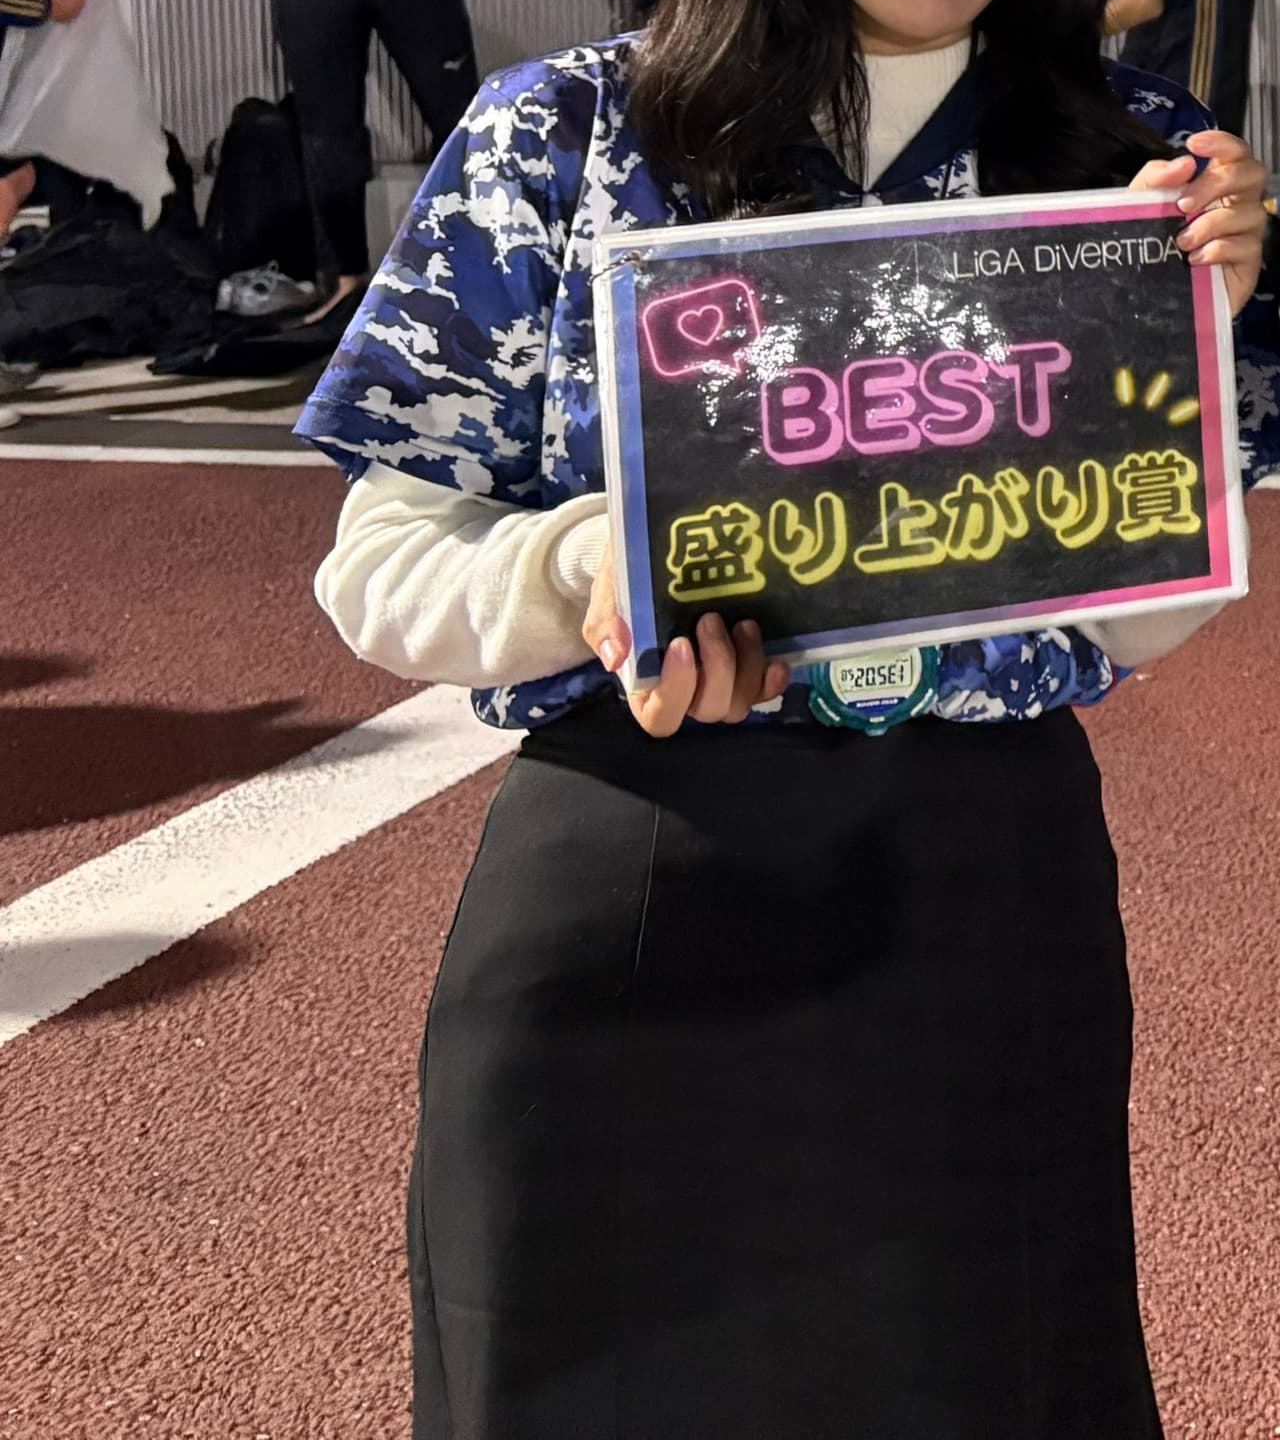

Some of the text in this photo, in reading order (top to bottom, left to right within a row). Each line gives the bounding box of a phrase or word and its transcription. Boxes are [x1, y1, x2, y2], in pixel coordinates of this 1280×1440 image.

[762, 342, 1071, 465] BEST
[668, 450, 1201, 601] 盛り上がり賞
